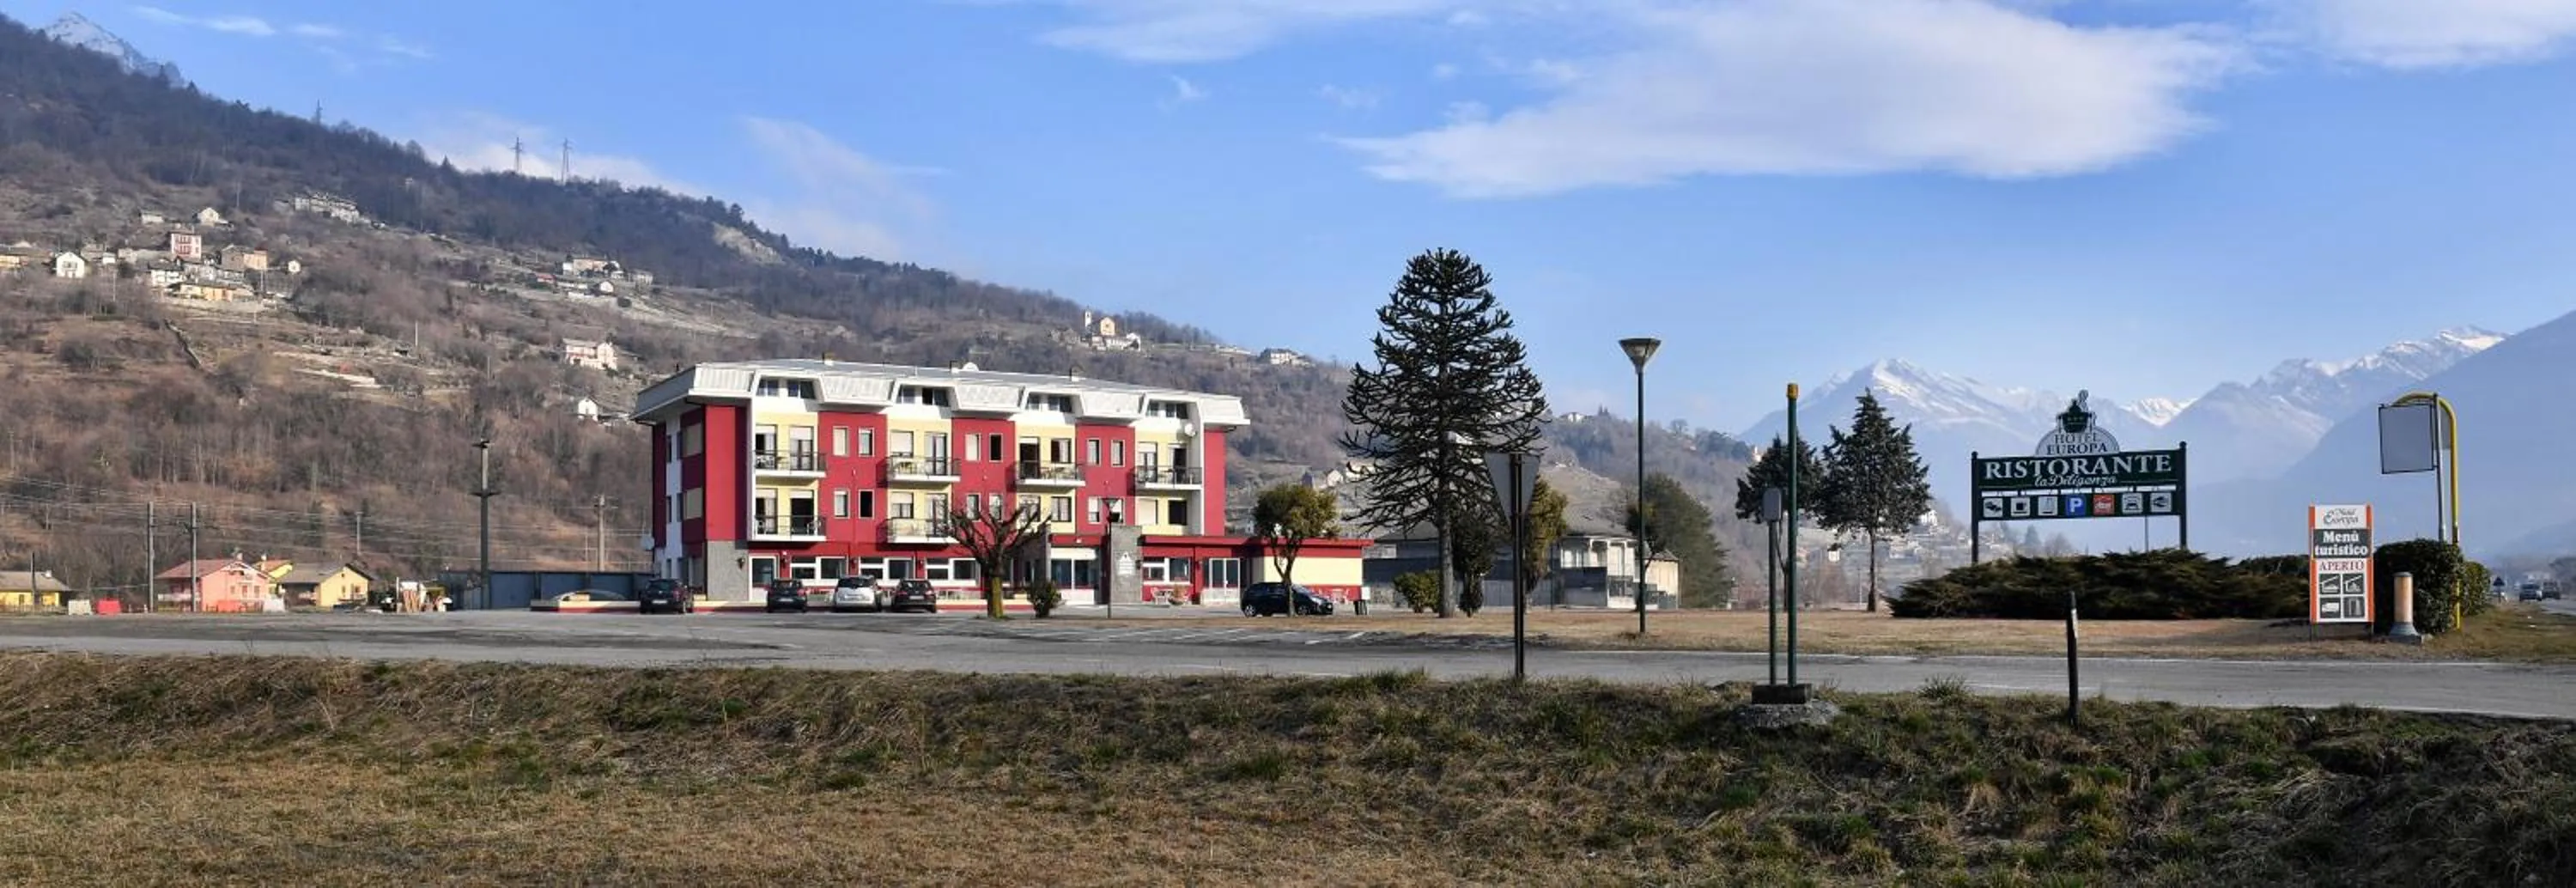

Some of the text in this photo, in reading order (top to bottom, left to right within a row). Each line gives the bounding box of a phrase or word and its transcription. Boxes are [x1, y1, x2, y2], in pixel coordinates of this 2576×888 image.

[2046, 442, 2108, 455] EUROPA
[1984, 454, 2172, 479] RISTORANTE
[2315, 544, 2368, 556] turistico
[2320, 561, 2364, 571] APERTO
